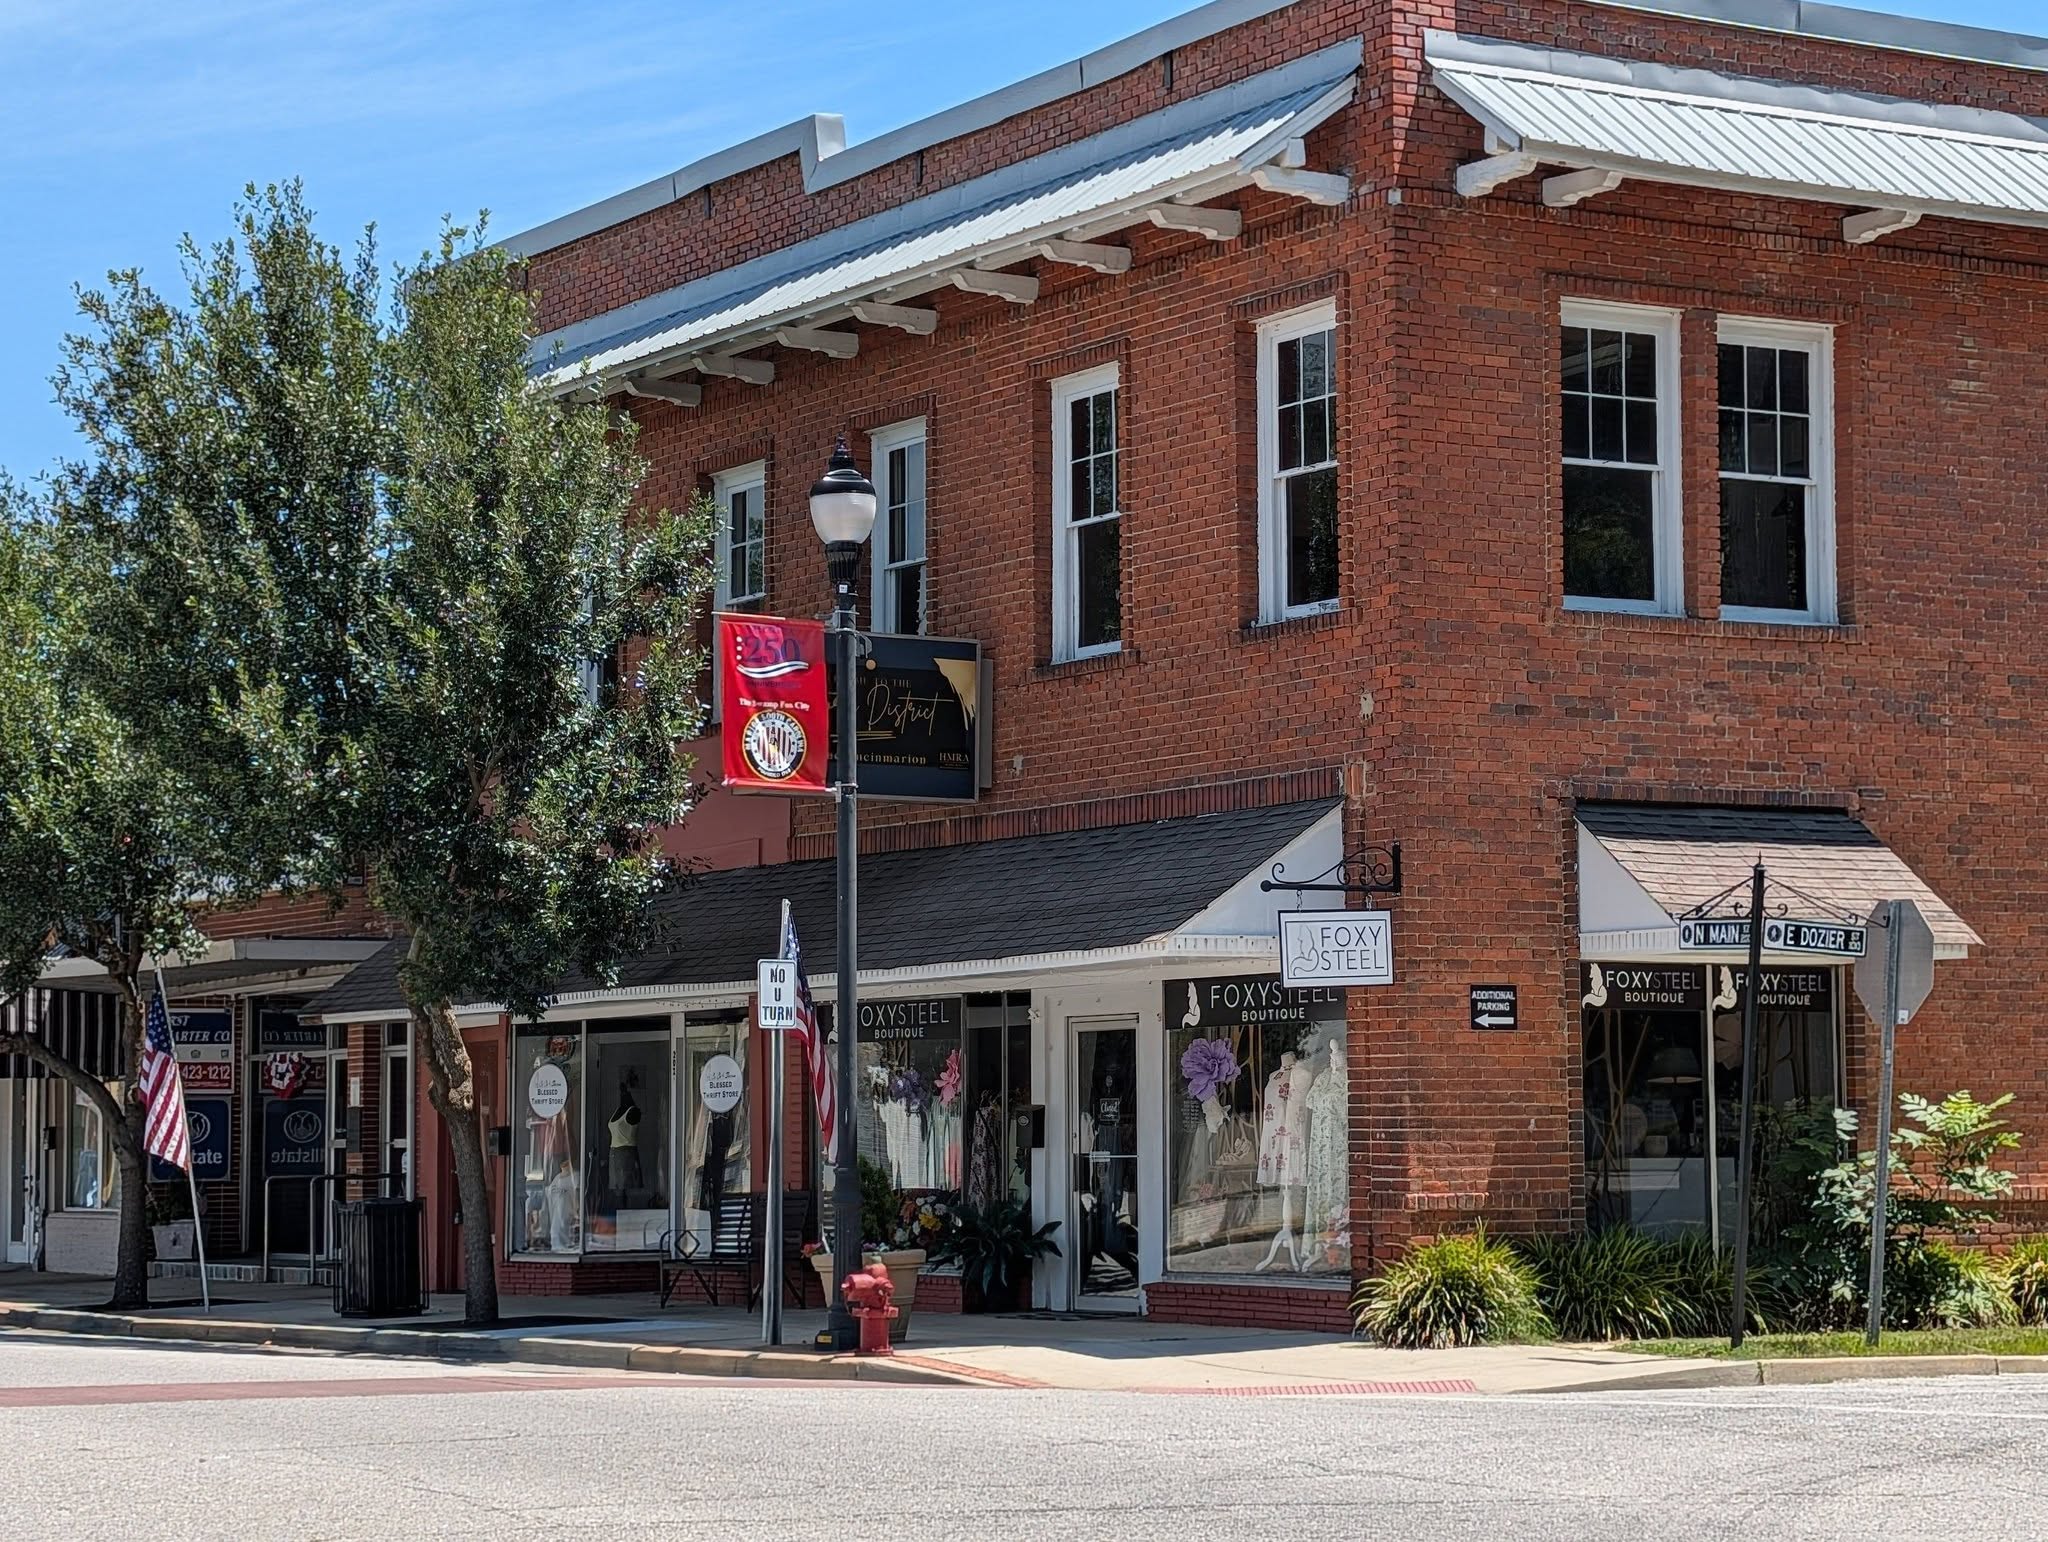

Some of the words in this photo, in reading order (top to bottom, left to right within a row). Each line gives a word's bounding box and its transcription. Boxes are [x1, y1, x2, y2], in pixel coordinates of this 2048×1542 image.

[743, 636, 801, 664] 250
[867, 681, 954, 736] District
[1320, 926, 1382, 947] FOXY
[1696, 925, 1705, 943] N
[1709, 925, 1740, 943] MAIN
[1786, 926, 1796, 945] E
[1800, 927, 1845, 950] DOZIER
[1321, 949, 1385, 970] STEEL
[770, 967, 786, 983] NO
[1606, 970, 1701, 990] FOXYSTEEL
[1735, 972, 1827, 992] FXYSTEEL
[774, 988, 781, 1001] U
[1471, 990, 1516, 1000] ADDITIONAL
[1624, 991, 1685, 1004] BOUTIQUE
[762, 1006, 793, 1021] TURN
[860, 1001, 950, 1027] OXYSTEEL
[1241, 1007, 1306, 1022] BOUTIQUE
[1477, 1001, 1510, 1011] PARKING
[874, 1026, 925, 1039] BOUTIQUE
[191, 1149, 223, 1164] tate
